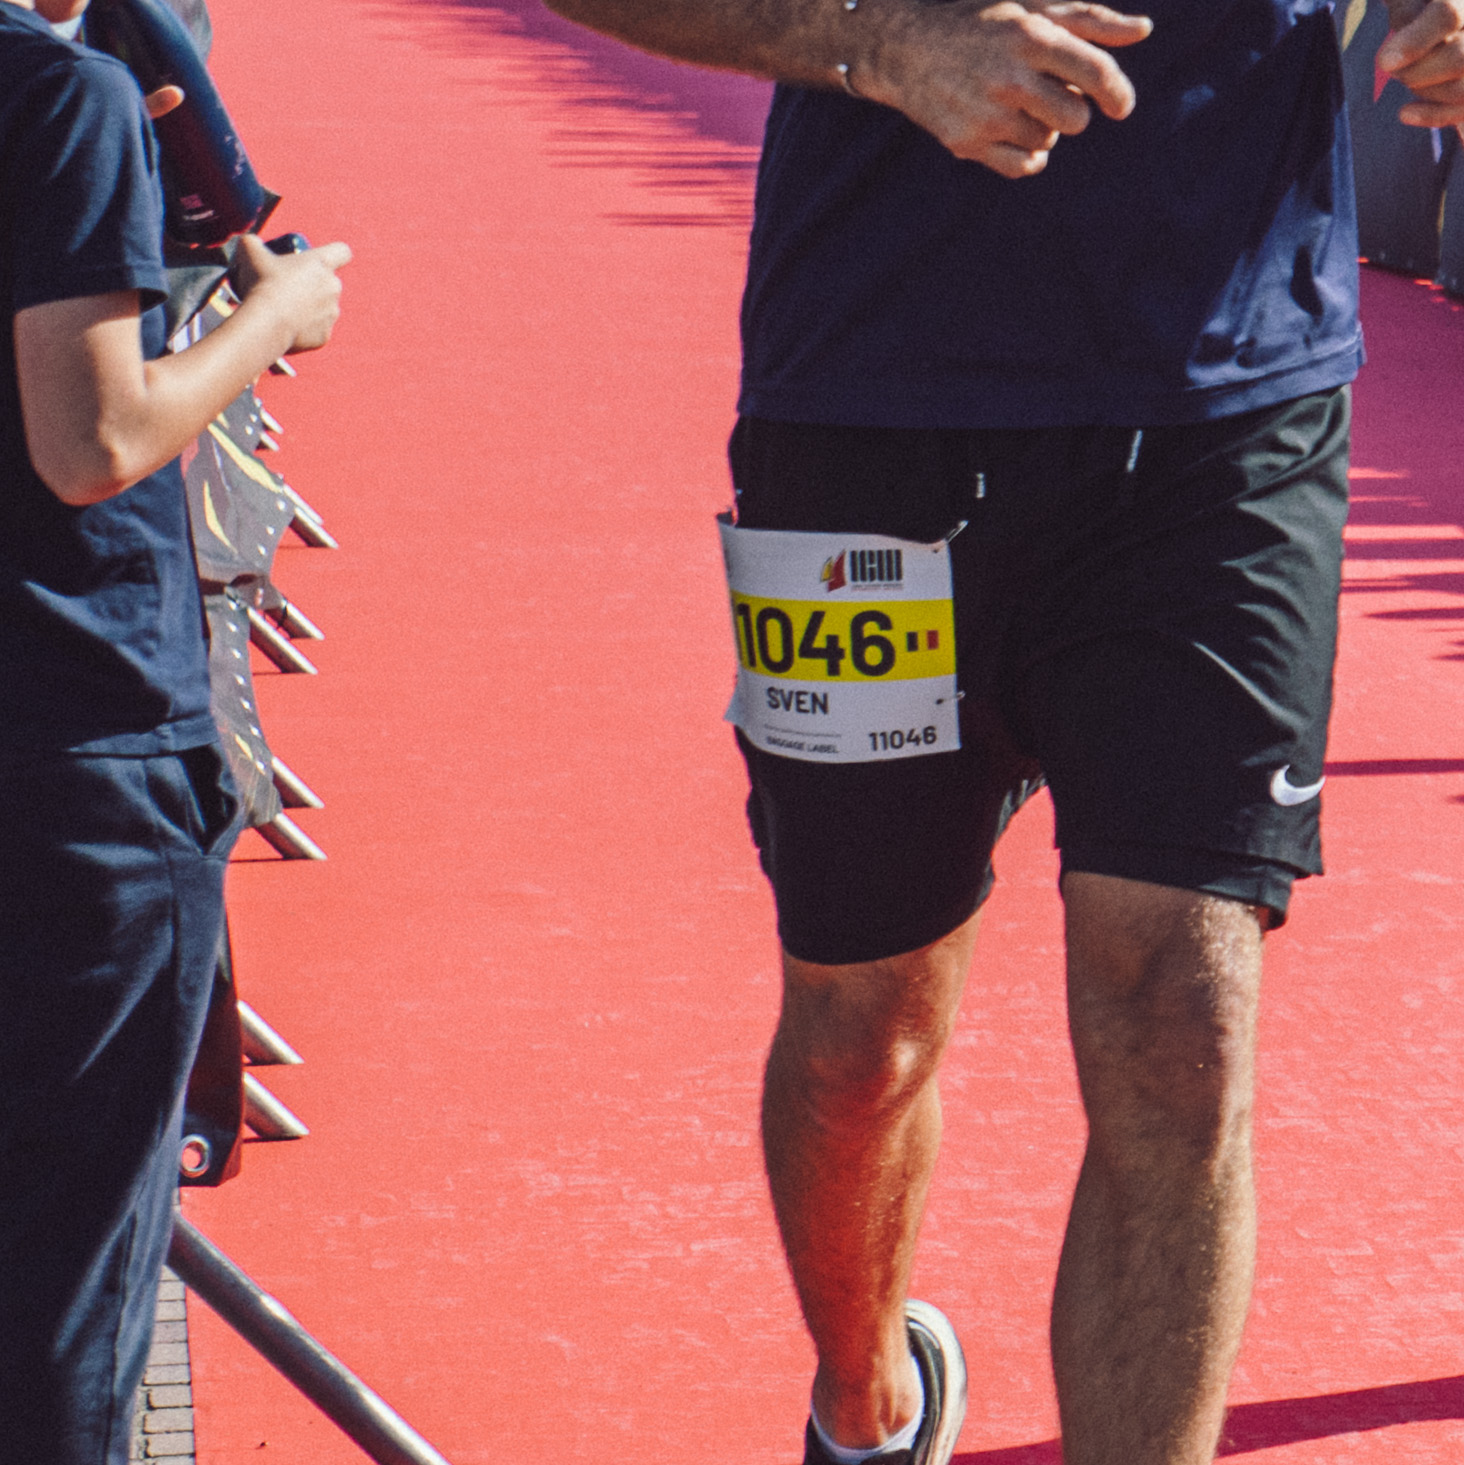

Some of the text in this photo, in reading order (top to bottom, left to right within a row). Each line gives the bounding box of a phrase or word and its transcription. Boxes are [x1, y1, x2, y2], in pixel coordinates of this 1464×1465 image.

[736, 603, 896, 677] 1046
[766, 687, 829, 715] SVEN
[868, 725, 938, 752] 11046
